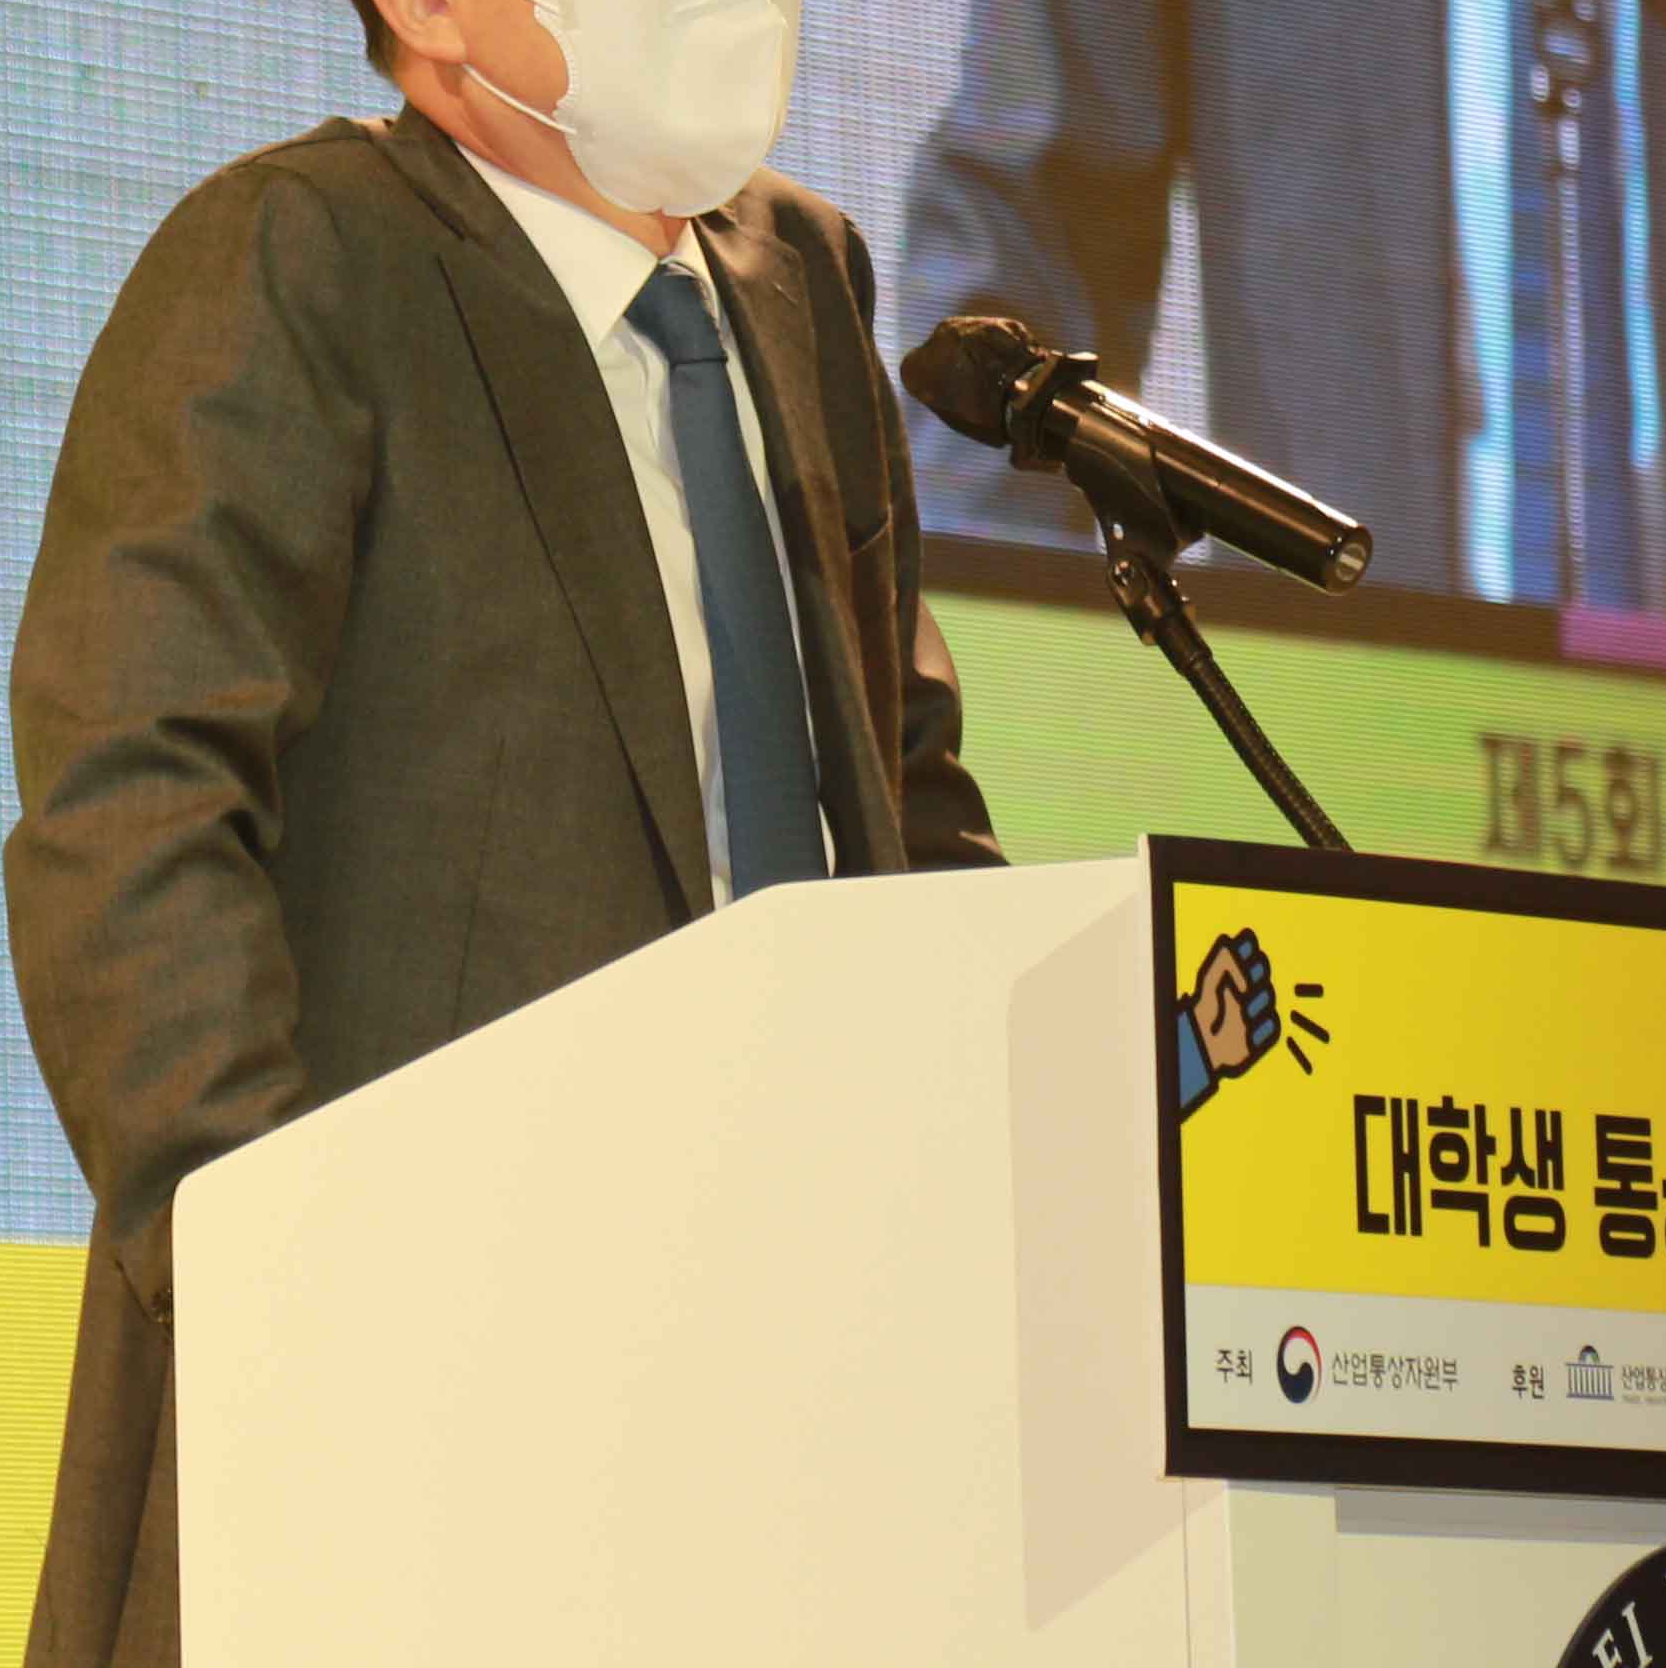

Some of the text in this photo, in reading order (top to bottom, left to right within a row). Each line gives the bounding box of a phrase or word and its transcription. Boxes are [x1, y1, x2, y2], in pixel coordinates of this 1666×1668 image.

[1482, 731, 1666, 874] 제5회
[1352, 1094, 1568, 1253] 대학생
[1216, 1349, 1460, 1392] 주최 산업통상자원부
[1511, 1363, 1546, 1399] 후원
